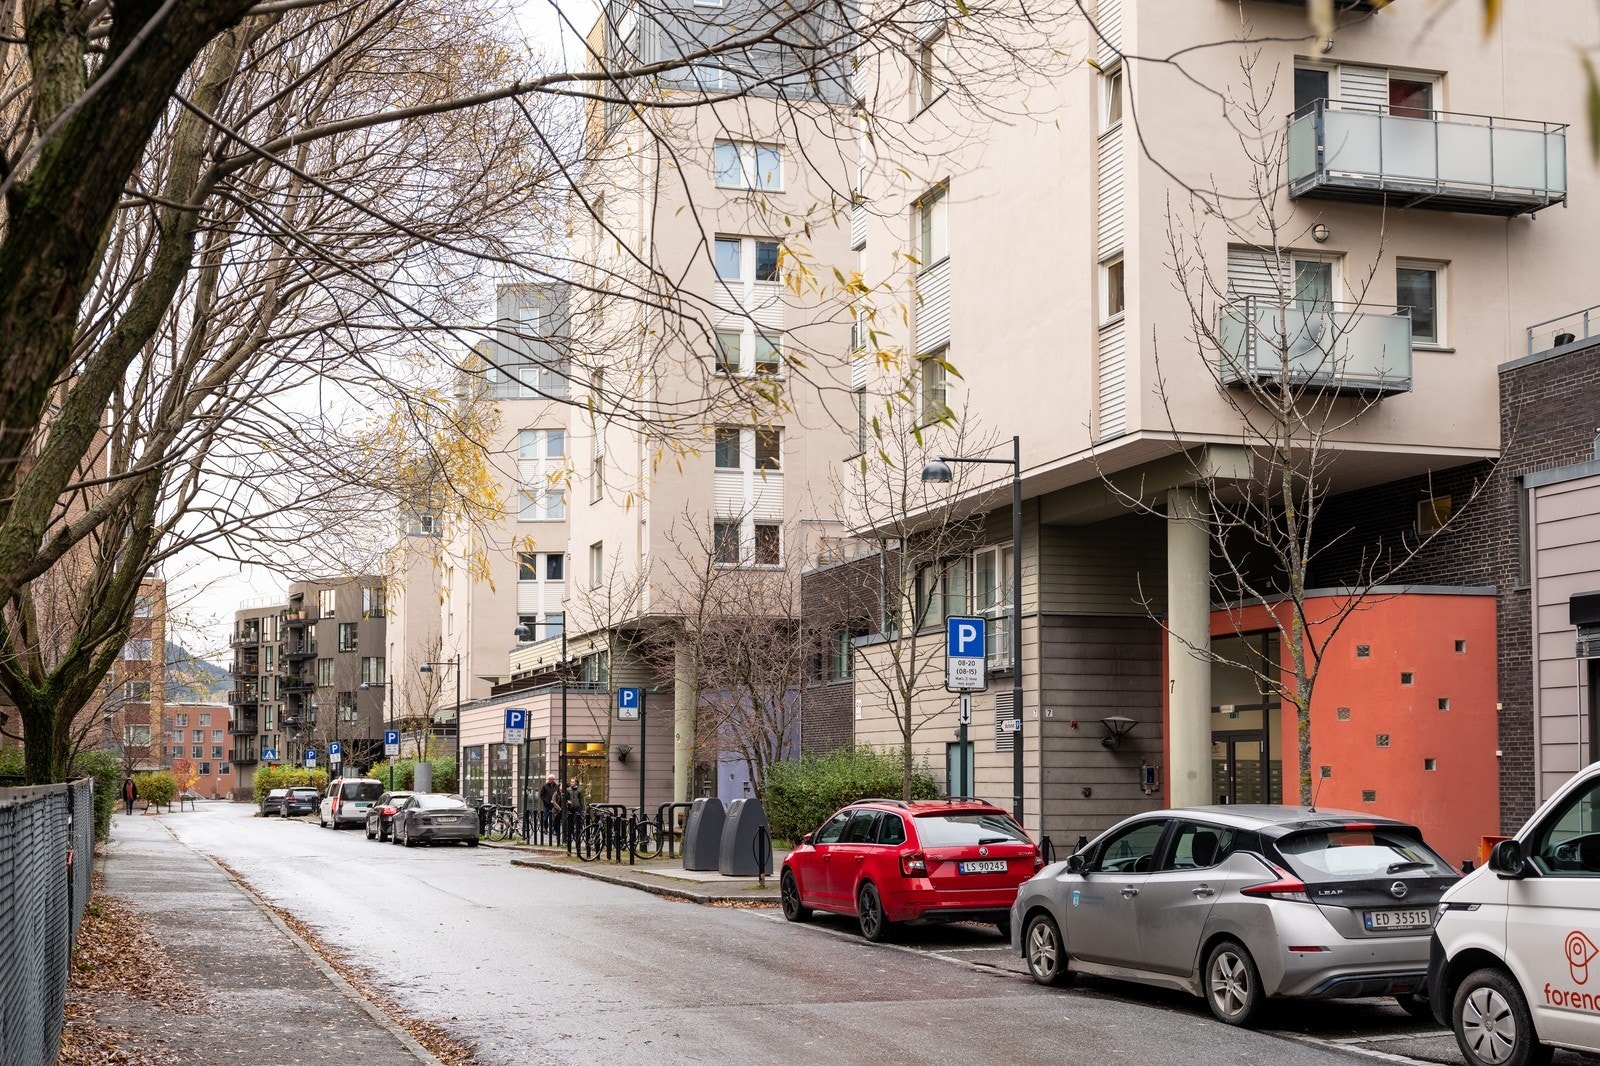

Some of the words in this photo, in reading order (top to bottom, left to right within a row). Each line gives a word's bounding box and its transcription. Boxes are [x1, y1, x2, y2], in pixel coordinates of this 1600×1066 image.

[959, 624, 977, 653] P
[956, 668, 977, 676] (08-15)
[1169, 679, 1176, 694] 7
[623, 690, 634, 706] P
[510, 712, 522, 727] P
[388, 732, 396, 744] P
[676, 733, 680, 741] 9
[308, 751, 315, 759] P
[331, 744, 338, 754] P
[966, 863, 976, 871] LS
[979, 861, 1005, 871] 90245
[1375, 913, 1390, 925] ED
[1394, 911, 1427, 924] 35515
